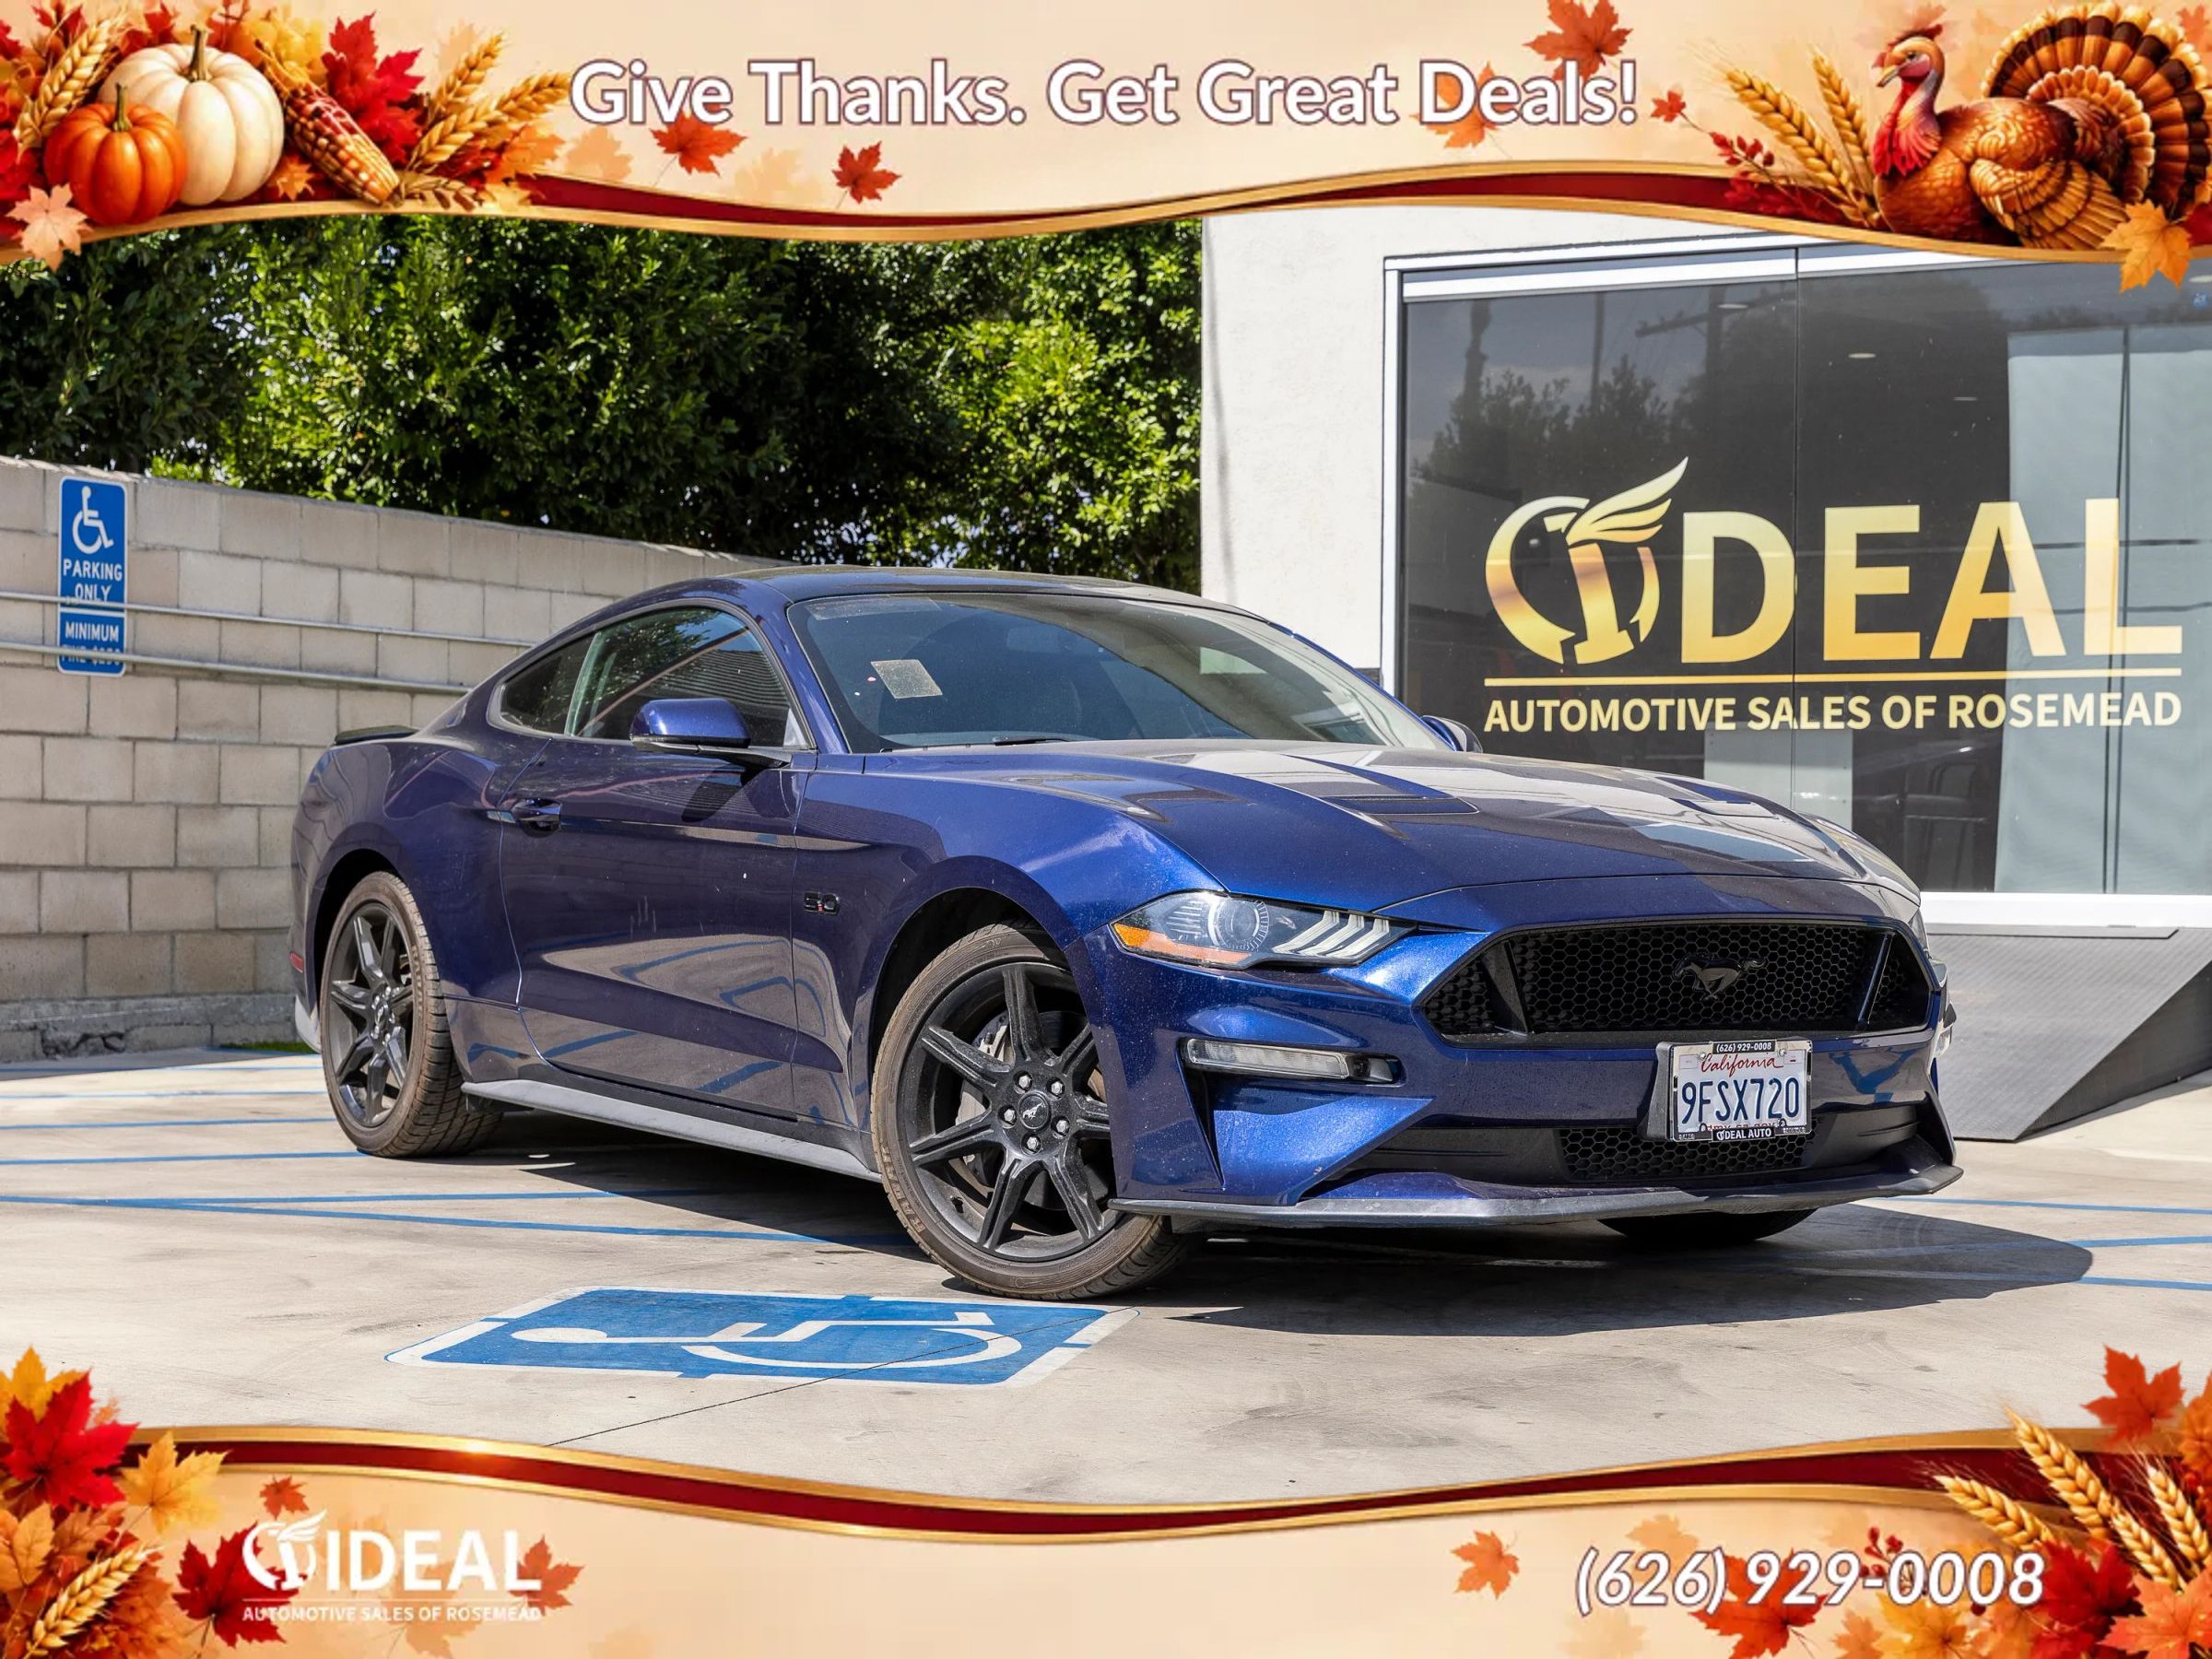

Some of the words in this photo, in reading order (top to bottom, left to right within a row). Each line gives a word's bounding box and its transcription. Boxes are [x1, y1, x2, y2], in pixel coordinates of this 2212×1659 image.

[63, 558, 122, 581] PARKING
[75, 582, 112, 602] ONLY
[65, 620, 119, 642] MINIMUM
[1485, 695, 1737, 733] AUTOMOTIVE
[1747, 695, 1873, 732] SALES
[1881, 694, 1936, 730] OF
[1947, 691, 2183, 730] ROSEMEAD
[1716, 1043, 1736, 1053] (626)
[1737, 1042, 1771, 1052] 929-0008
[1700, 1053, 1784, 1077] California
[1681, 1077, 1800, 1124] 9FSX720
[1747, 1127, 1772, 1139] AUTO
